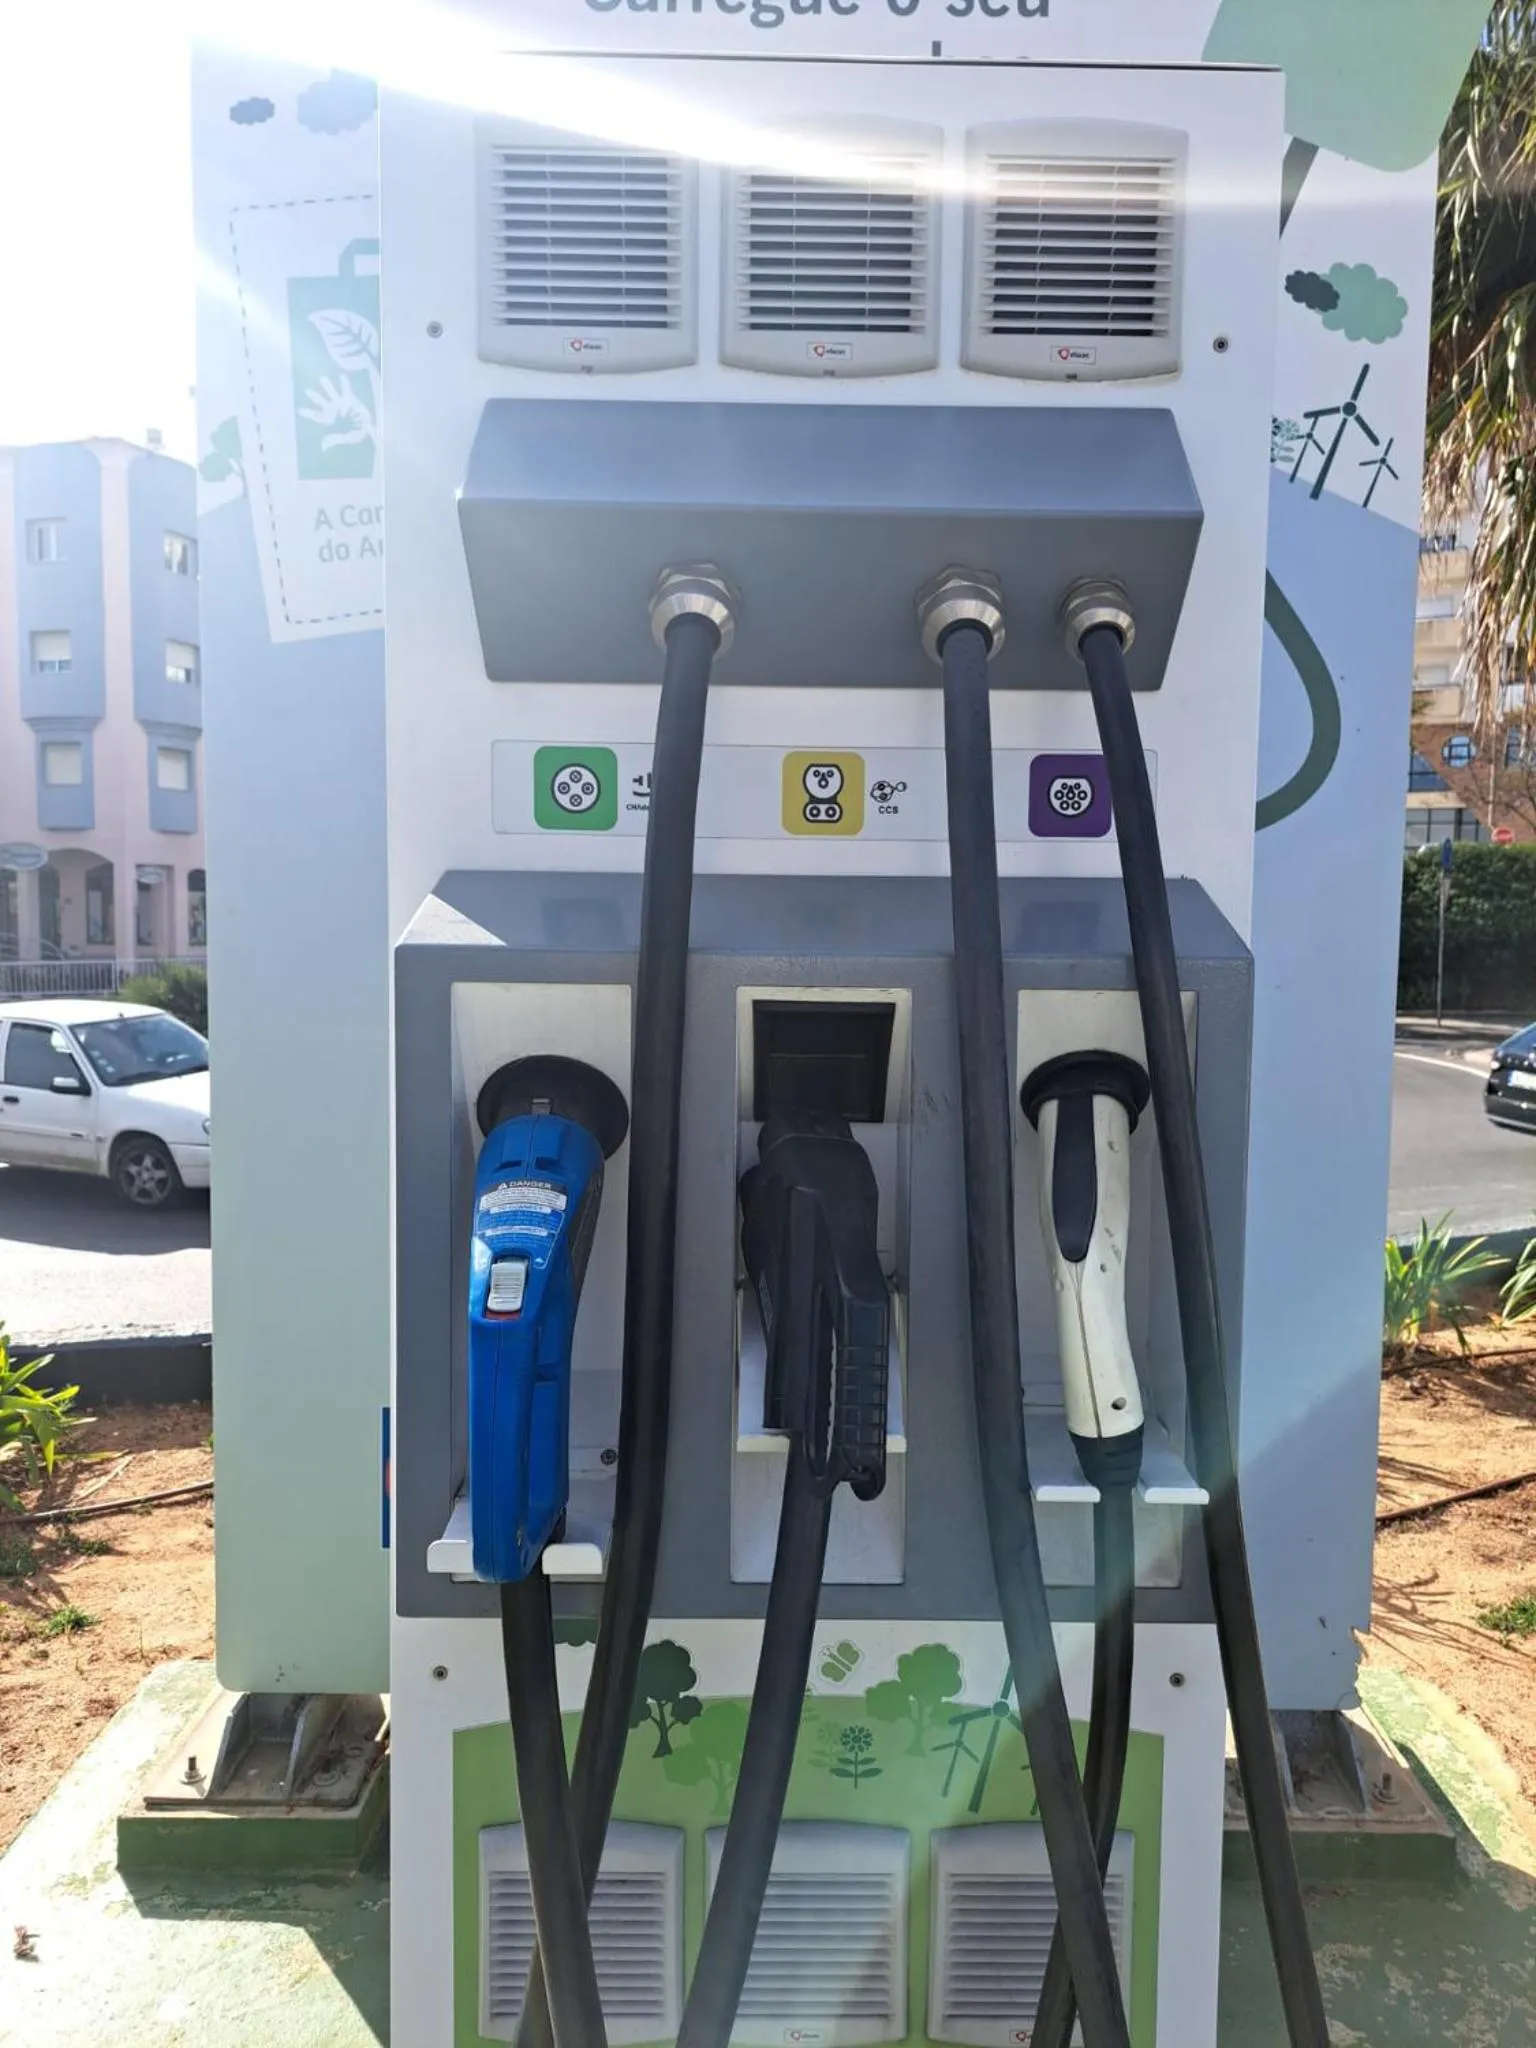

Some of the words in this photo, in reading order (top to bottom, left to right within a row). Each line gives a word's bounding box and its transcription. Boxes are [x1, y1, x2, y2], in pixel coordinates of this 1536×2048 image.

[314, 507, 334, 532] A
[318, 538, 351, 563] do
[878, 805, 899, 815] CCS
[509, 1180, 552, 1189] DANGER
